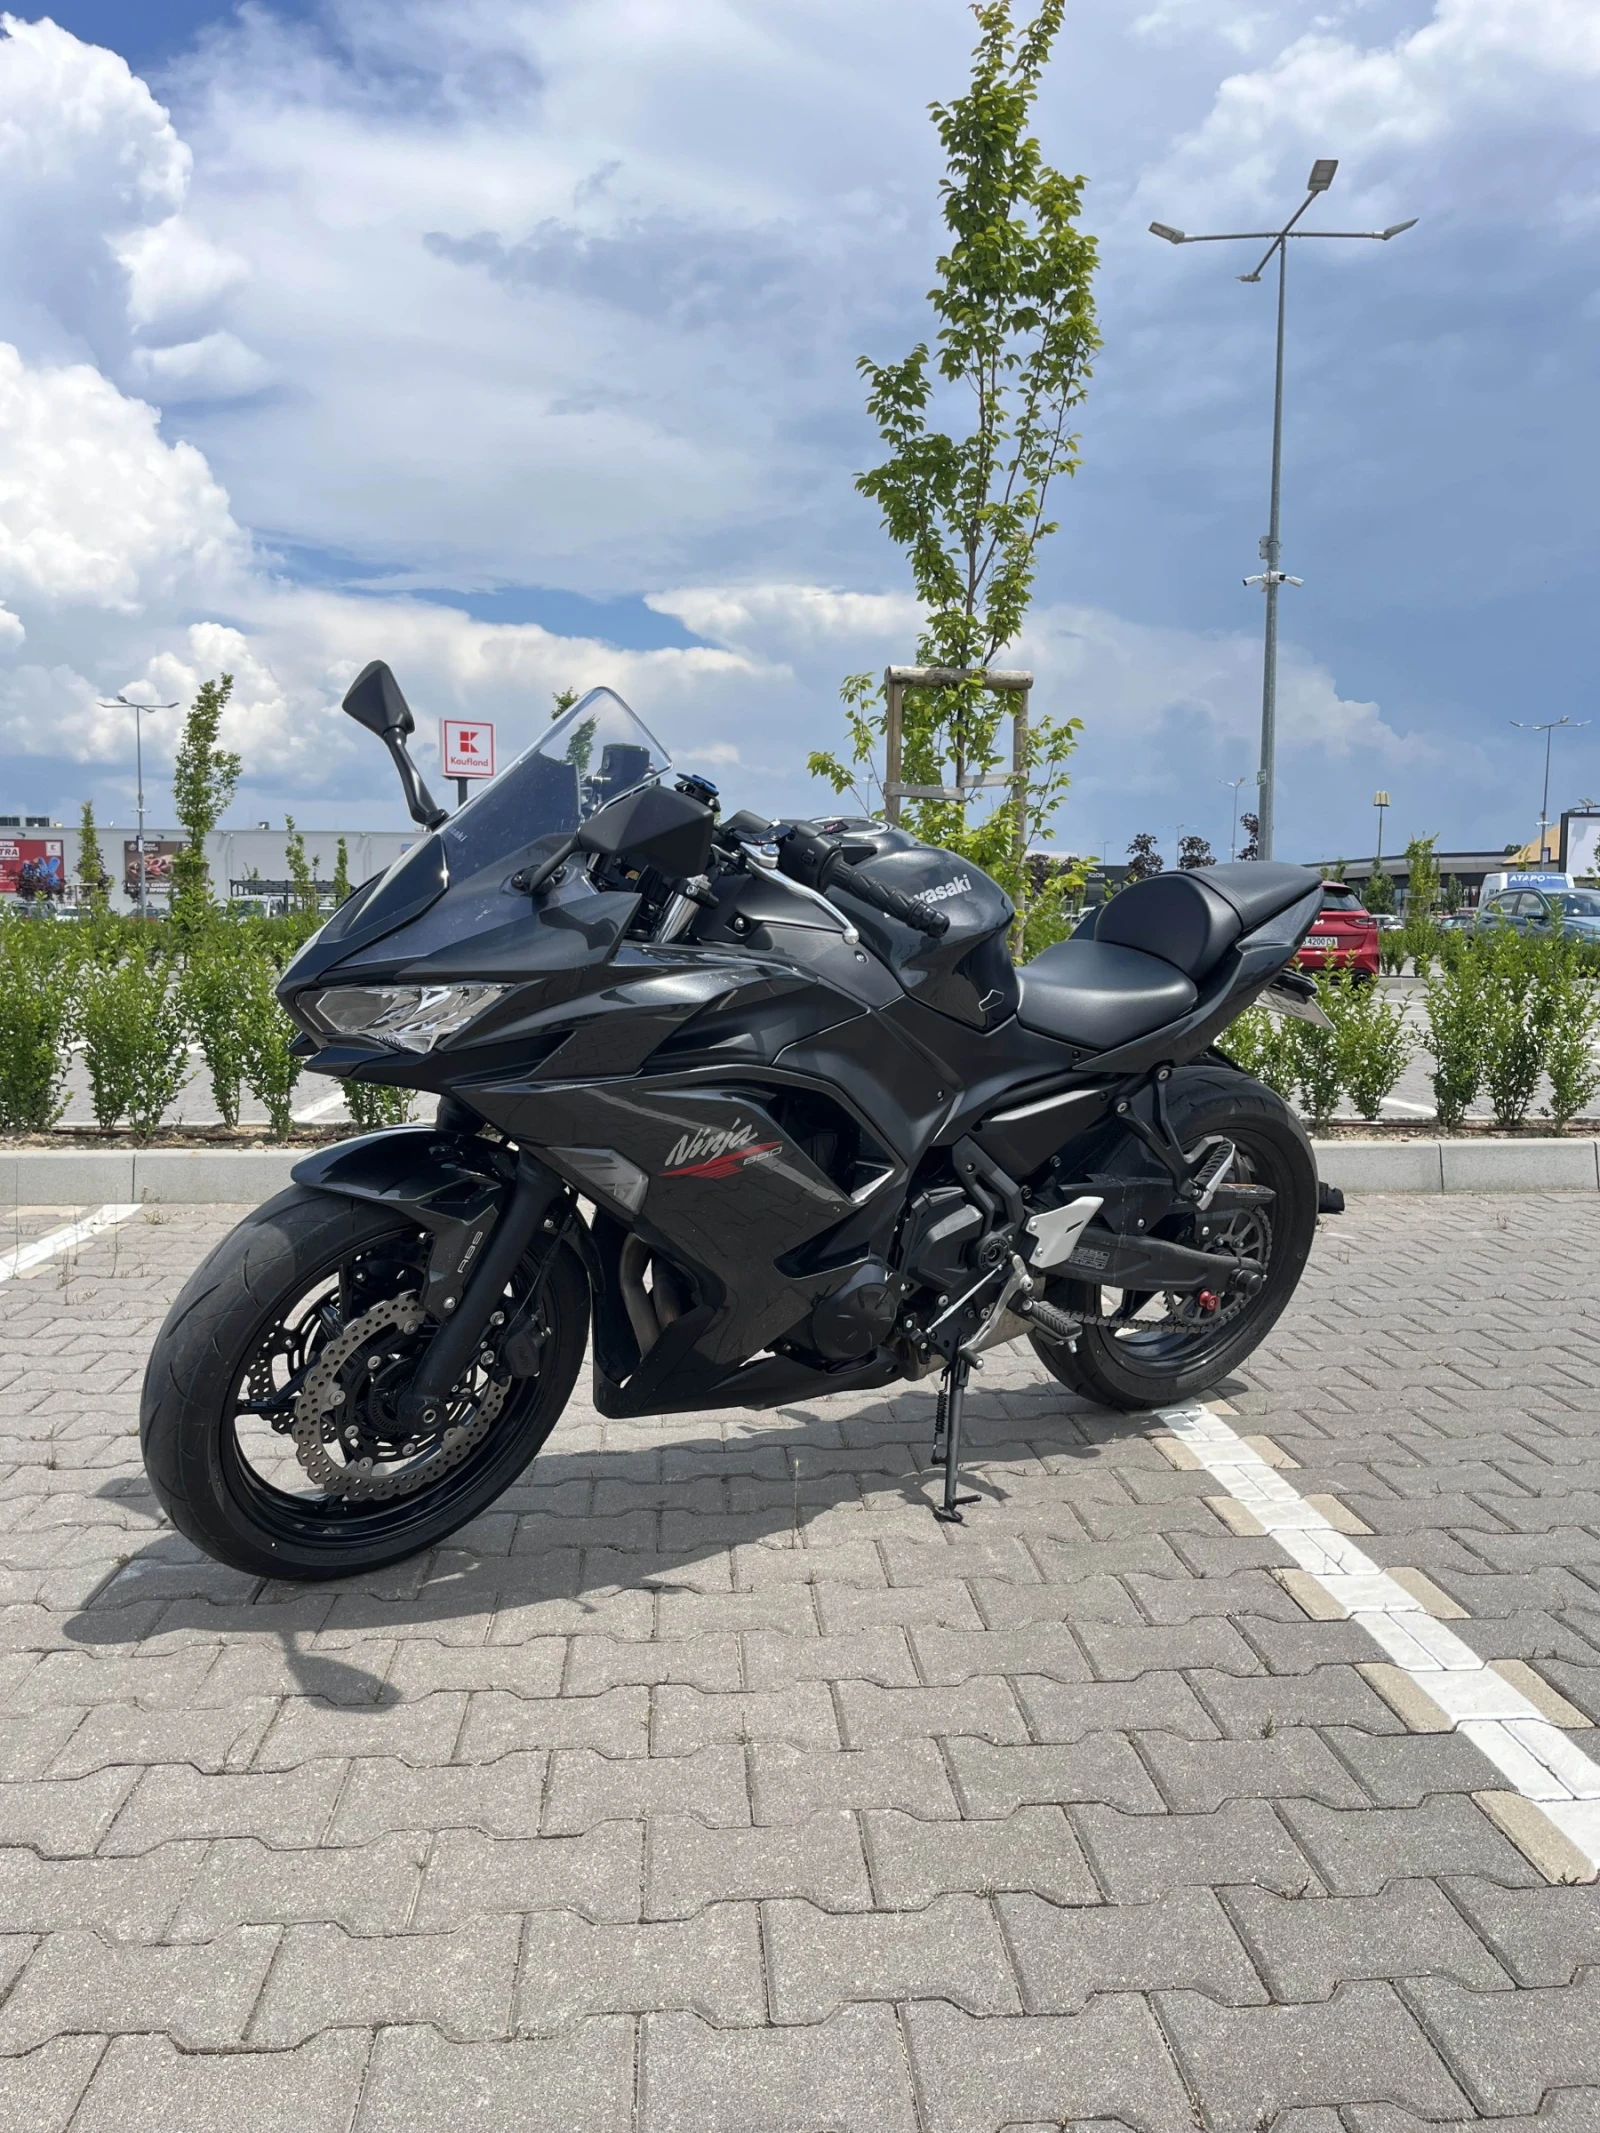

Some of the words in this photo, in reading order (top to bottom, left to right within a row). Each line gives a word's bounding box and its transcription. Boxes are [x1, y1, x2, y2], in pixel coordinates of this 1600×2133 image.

[450, 756, 489, 767] Kaufland
[1308, 937, 1325, 946] 4200
[664, 1117, 759, 1167] Ninja
[742, 1146, 783, 1166] 650
[457, 1230, 484, 1274] ABS
